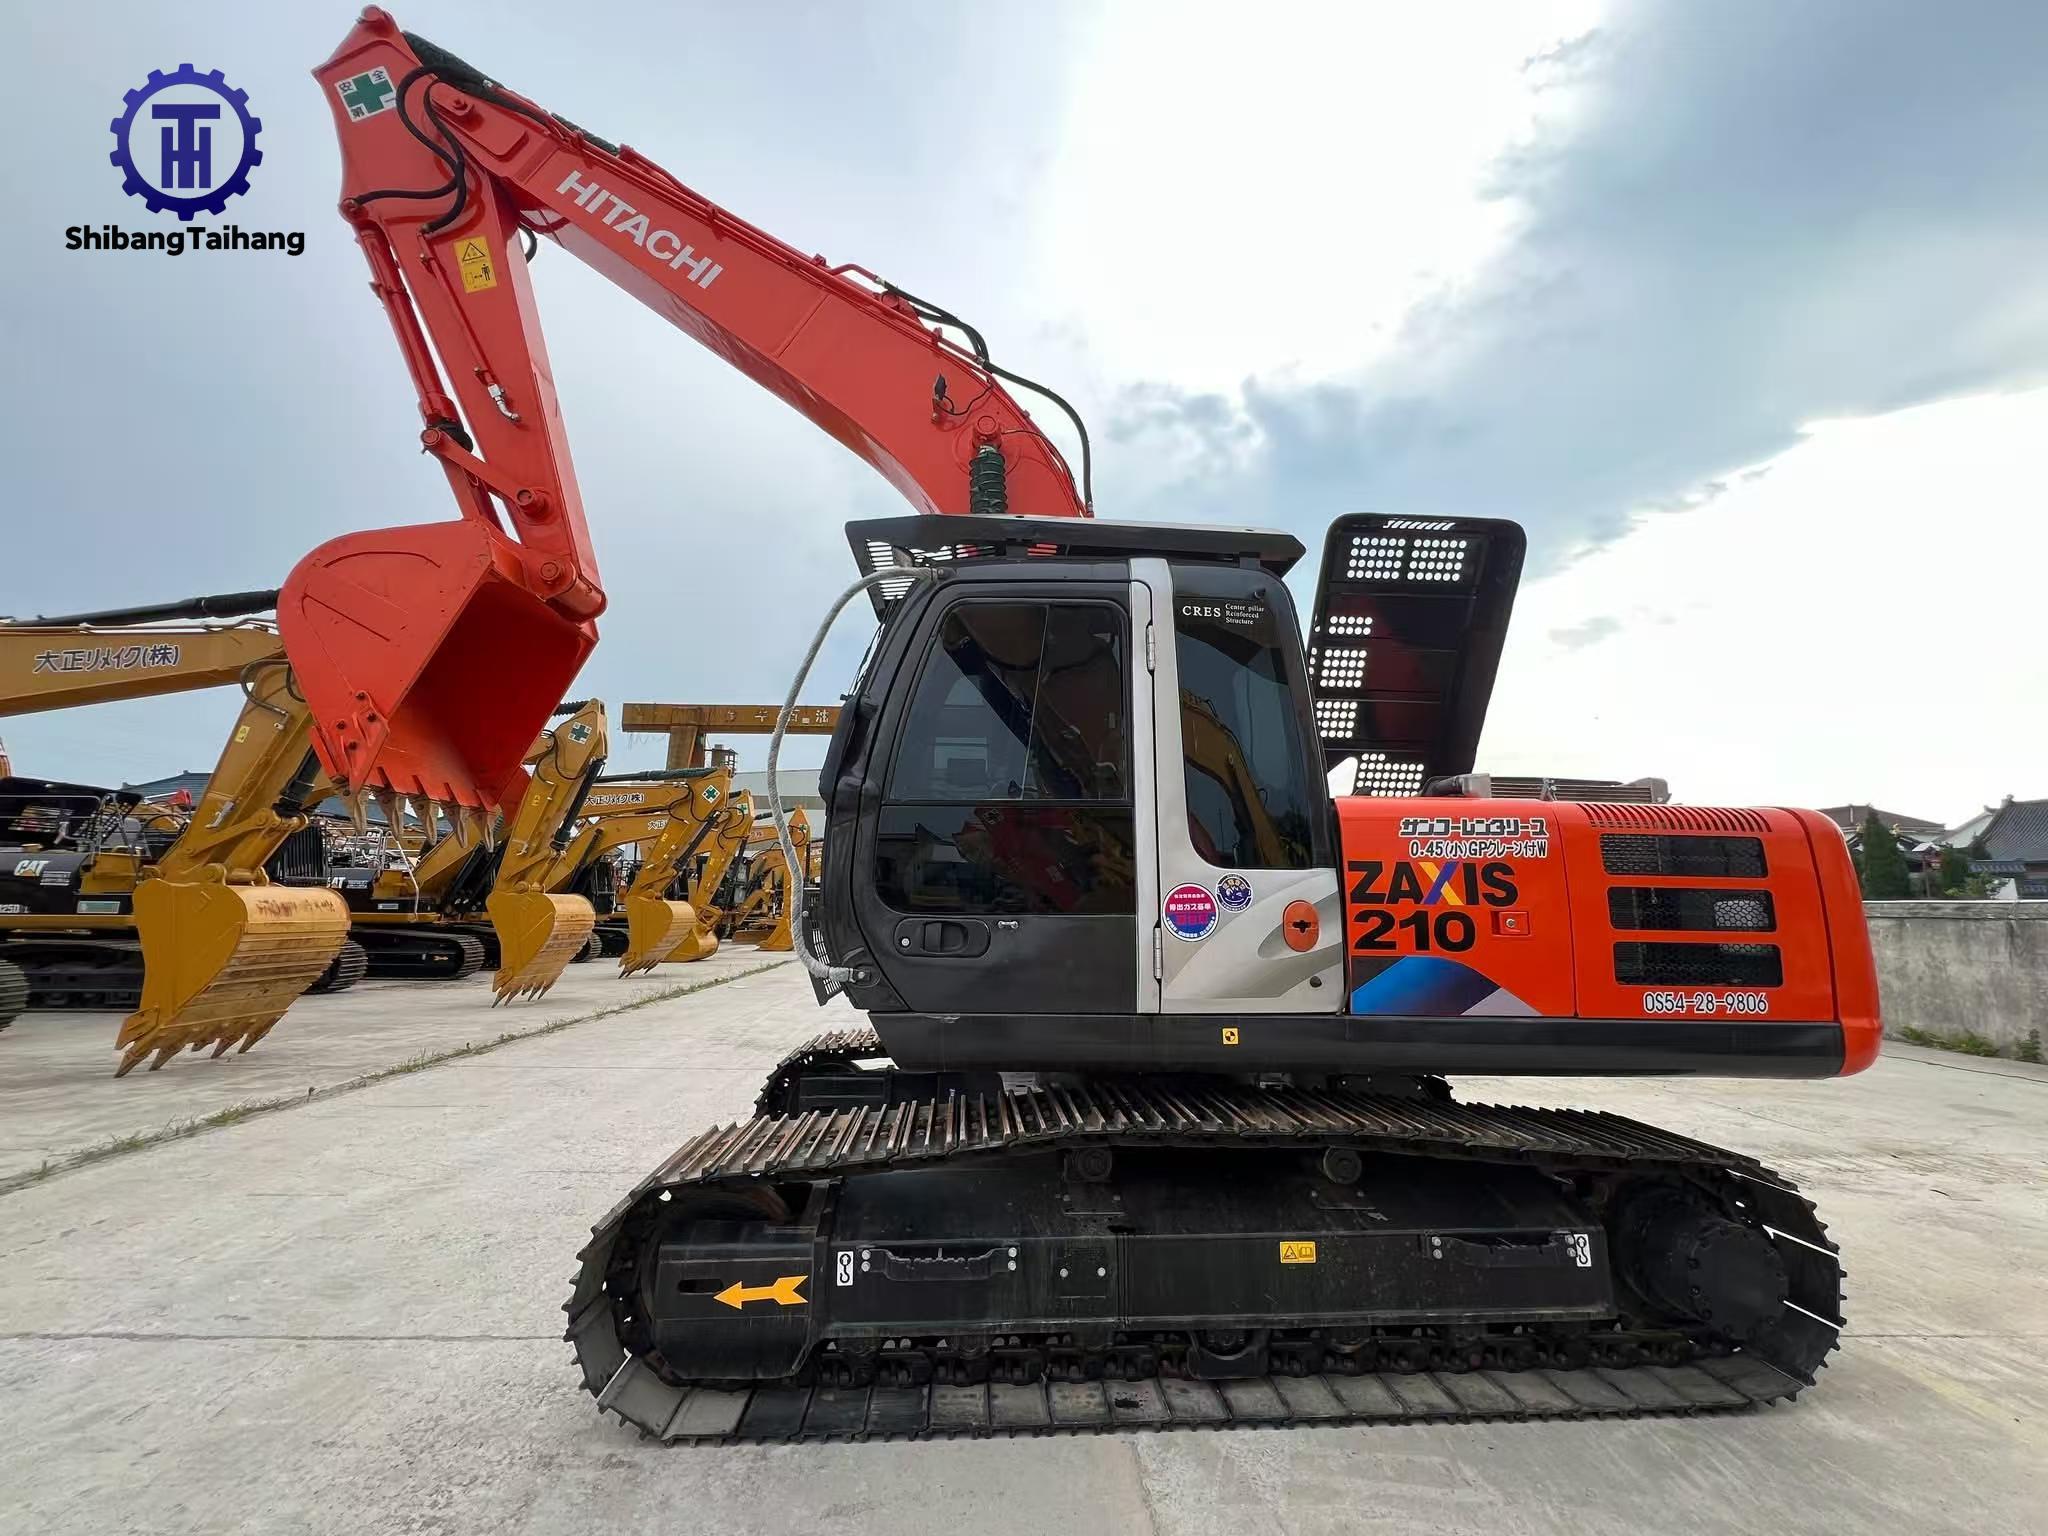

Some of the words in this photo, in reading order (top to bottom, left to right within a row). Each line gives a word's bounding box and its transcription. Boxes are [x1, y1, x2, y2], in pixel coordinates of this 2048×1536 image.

[556, 170, 723, 289] HITACHI
[1182, 605, 1221, 618] CRES
[1225, 603, 1246, 611] Center
[1248, 605, 1265, 613] pillar
[1225, 611, 1259, 619] Reinforced
[1225, 617, 1254, 625] Structure
[32, 643, 180, 674] 大正リメイク(株)
[1399, 817, 1549, 837] サンコーレンタリース
[14, 860, 49, 876] CAT
[1347, 860, 1519, 907] ZAXIS
[1353, 909, 1477, 952] 210
